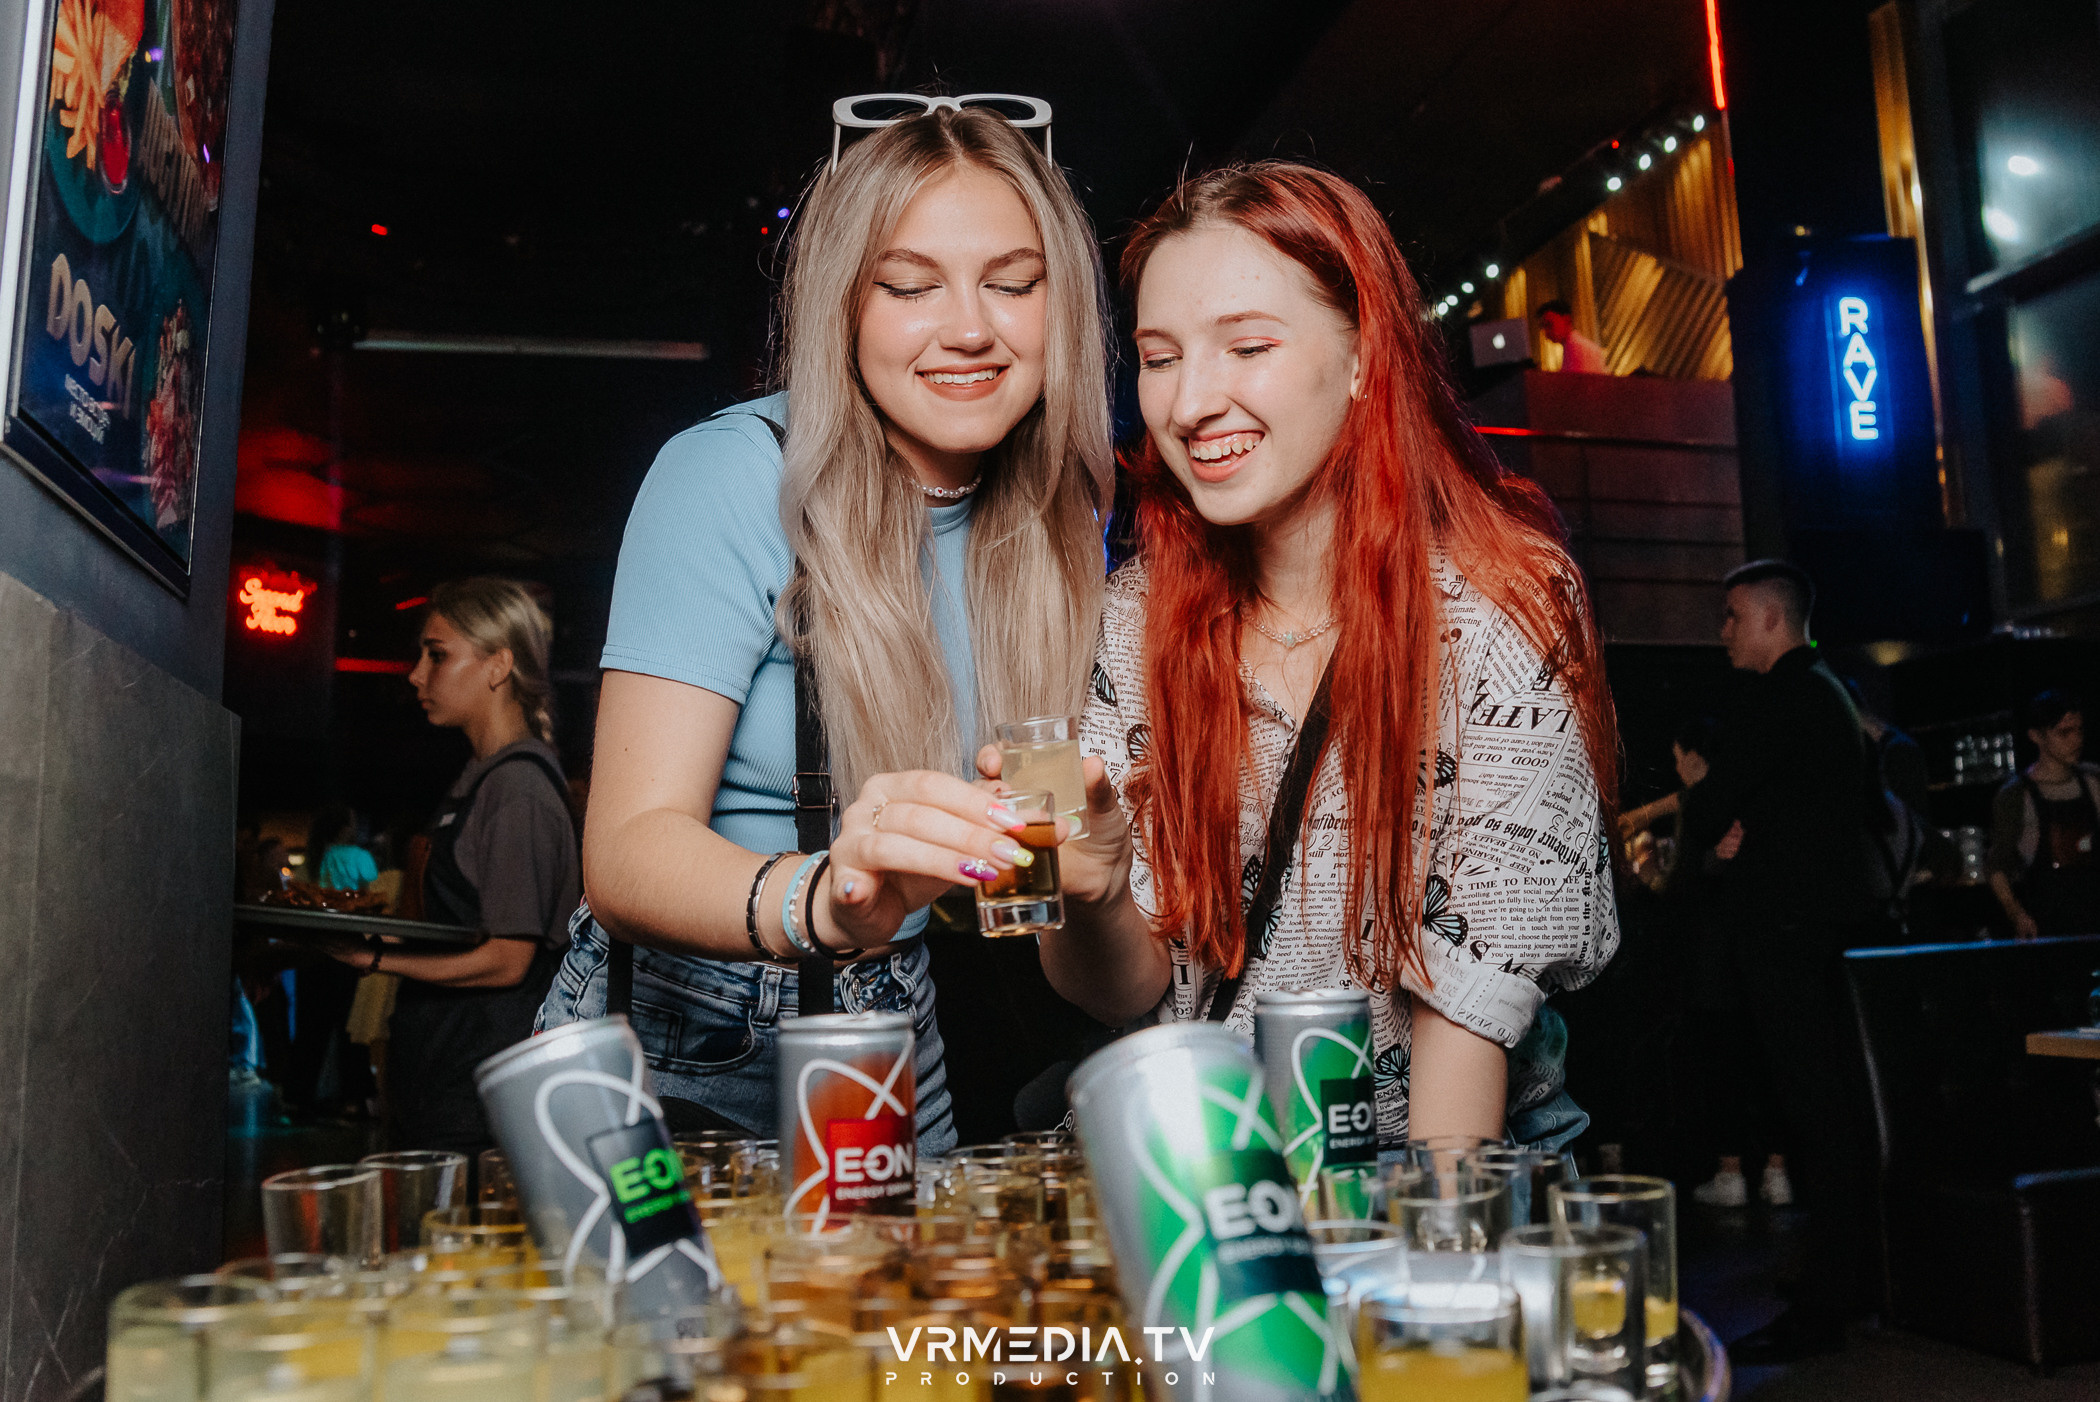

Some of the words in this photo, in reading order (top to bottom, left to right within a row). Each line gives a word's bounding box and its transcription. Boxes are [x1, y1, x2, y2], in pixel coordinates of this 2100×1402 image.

[46, 253, 136, 420] DOSKI
[1839, 297, 1879, 440] RAVE
[1473, 752, 1502, 763] OLD
[1511, 756, 1550, 768] GOOD
[1545, 790, 1572, 804] people's
[1540, 799, 1569, 816] worrying
[1462, 847, 1502, 864] WEARING
[1509, 844, 1526, 856] BUT
[1528, 850, 1541, 859] NO
[1510, 861, 1532, 874] KEEP
[1468, 880, 1498, 890] TIME
[1502, 878, 1518, 886] TO
[1524, 877, 1558, 886] ENJOY
[1376, 1086, 1400, 1100] ENJO
[1328, 1101, 1374, 1134] EO
[609, 1148, 685, 1204] EO
[1205, 1179, 1300, 1240] EO
